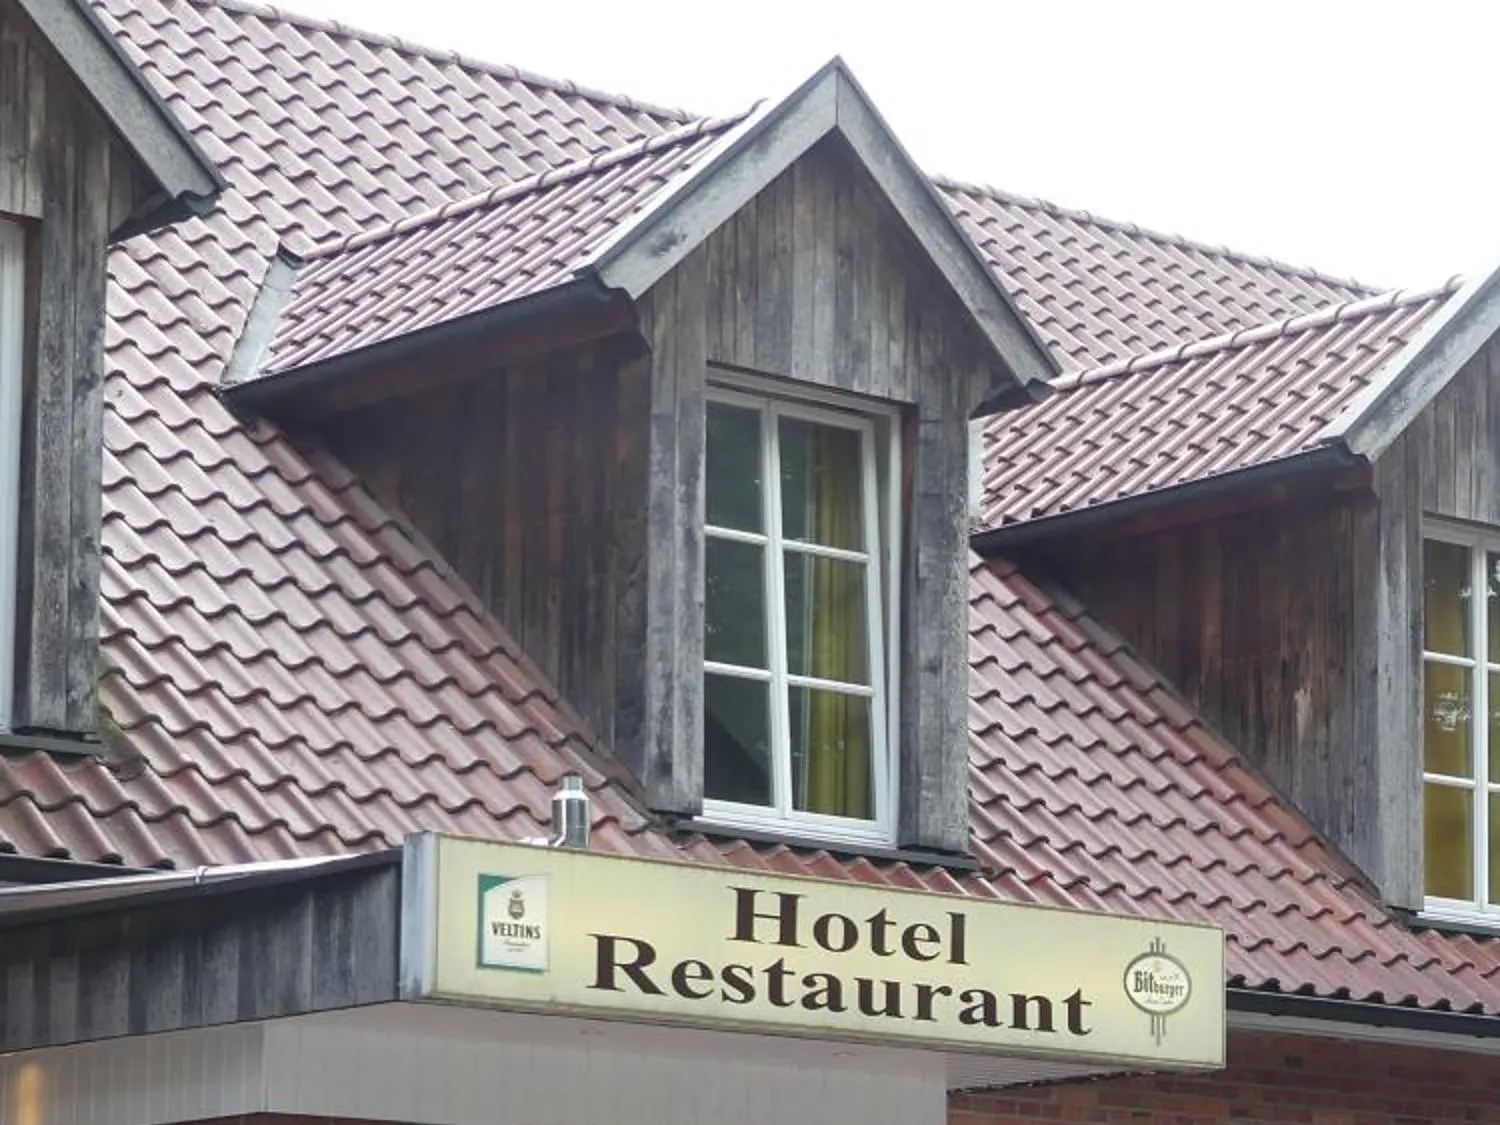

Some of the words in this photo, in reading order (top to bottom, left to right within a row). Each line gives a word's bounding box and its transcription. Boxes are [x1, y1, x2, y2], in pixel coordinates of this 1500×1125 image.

[491, 921, 541, 940] VELTINS
[726, 886, 970, 966] Hotel
[586, 933, 1092, 1036] Restaurant
